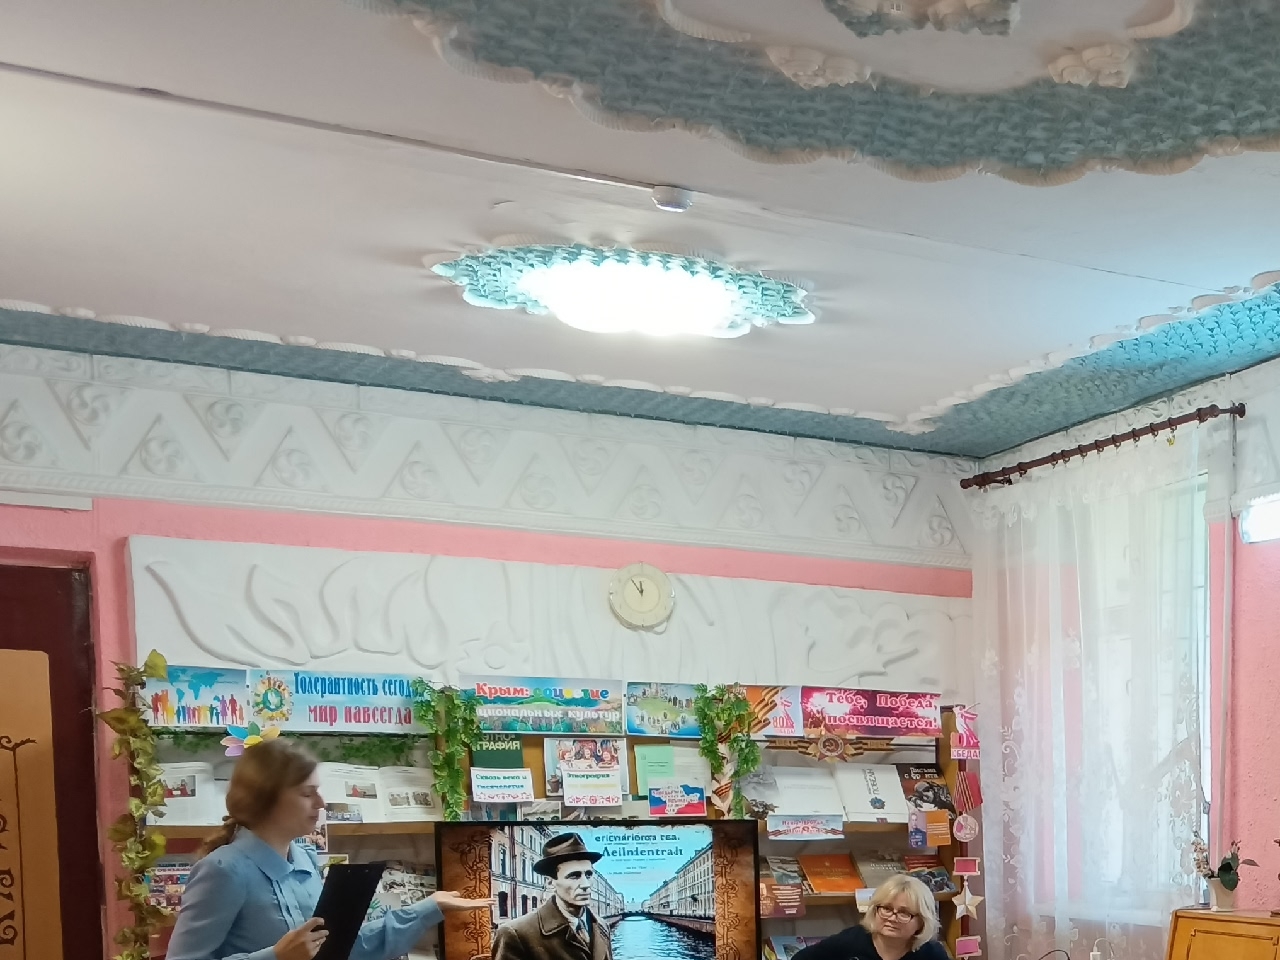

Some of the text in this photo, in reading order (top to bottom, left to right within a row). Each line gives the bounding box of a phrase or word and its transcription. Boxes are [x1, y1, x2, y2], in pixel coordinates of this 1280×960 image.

[294, 672, 424, 698] Толерантность сегод
[475, 683, 610, 700] Крым: соцветие
[826, 691, 937, 710] Тебе, Победа,
[308, 705, 412, 726] мир навсегда
[568, 710, 621, 721] культур
[826, 715, 938, 729] посвящается!
[477, 741, 521, 750] ГРАФИЯ
